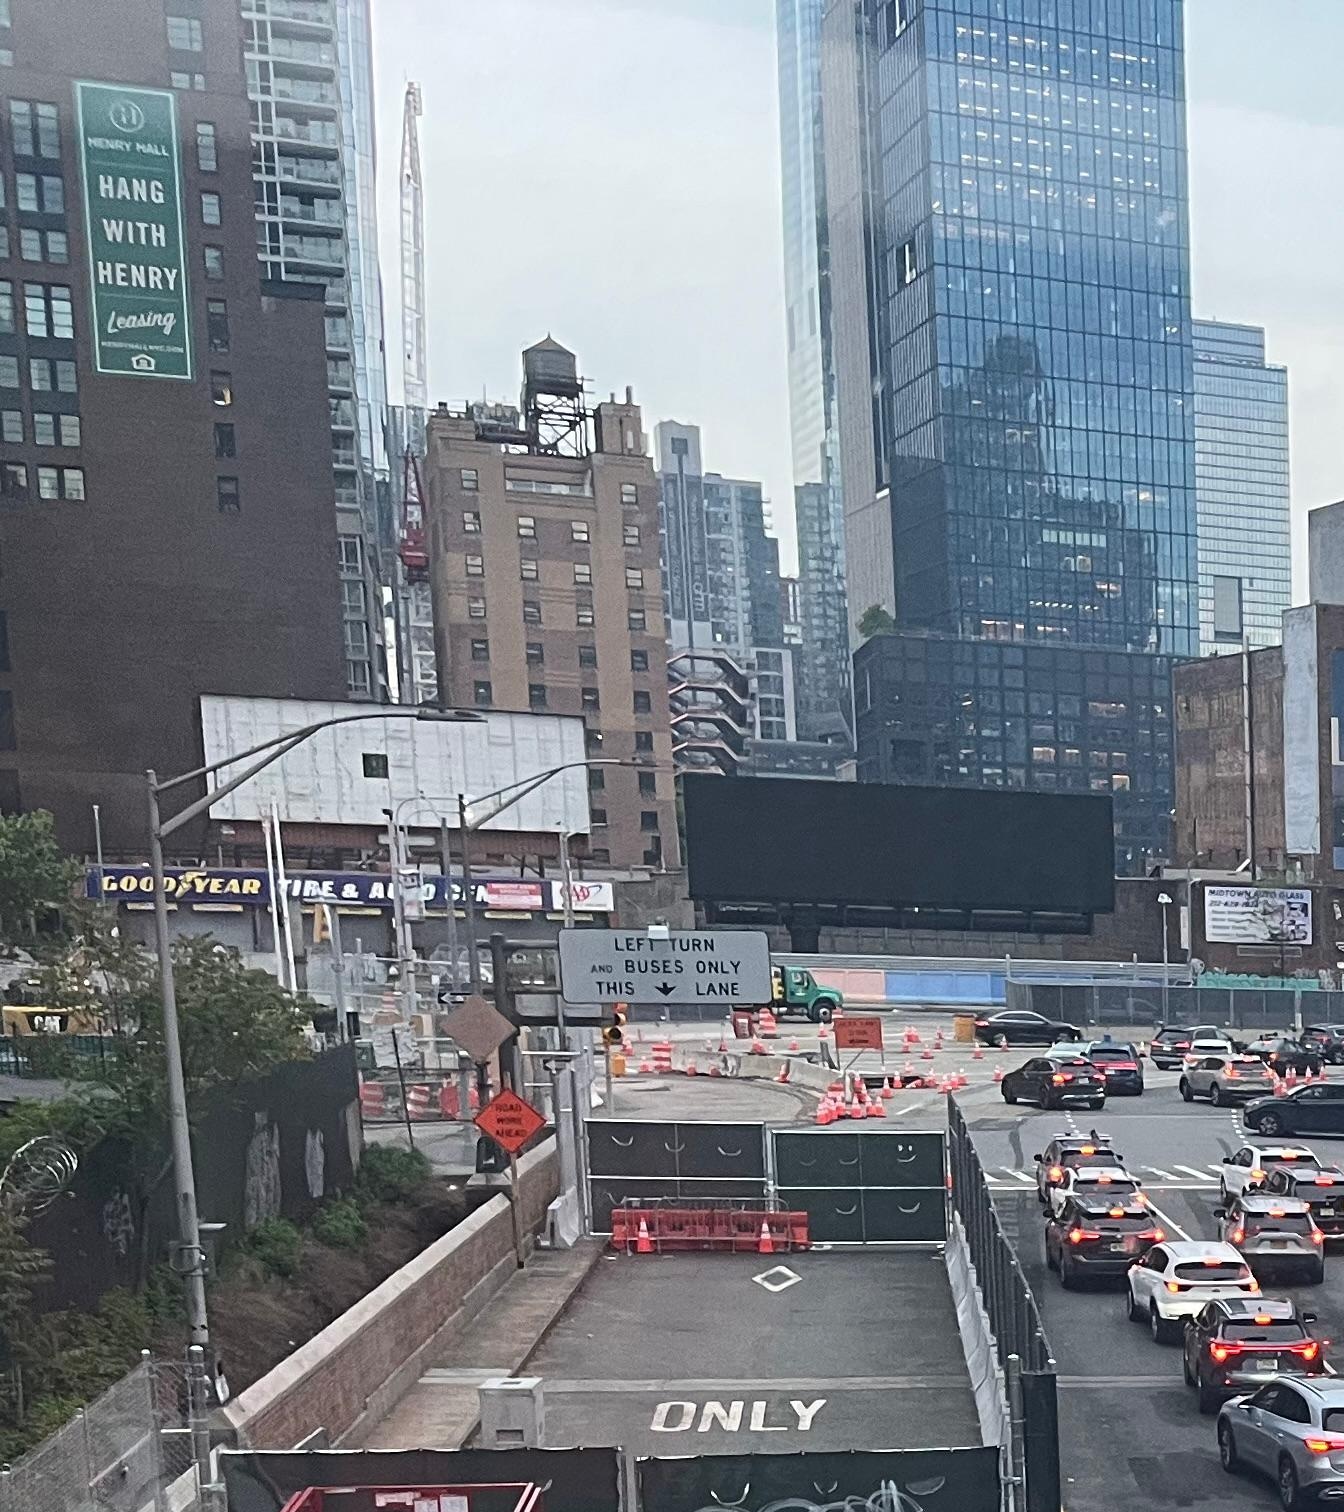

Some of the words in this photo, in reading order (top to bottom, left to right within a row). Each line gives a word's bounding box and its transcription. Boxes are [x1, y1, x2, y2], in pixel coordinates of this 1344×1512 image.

[136, 143, 169, 157] HALL
[99, 174, 164, 204] HANG
[103, 218, 166, 247] WITH
[97, 261, 178, 290] HENRY
[107, 311, 176, 335] Leasing
[103, 874, 261, 895] GOODYEAR
[341, 884, 359, 899] &
[614, 938, 656, 952] LEFT
[671, 938, 715, 952] TURN
[591, 965, 612, 973] AND
[625, 960, 684, 974] BUSES
[696, 961, 741, 974] ONLY
[596, 981, 635, 995] THIS
[696, 983, 740, 996] LANE
[650, 1398, 827, 1435] ONLY
